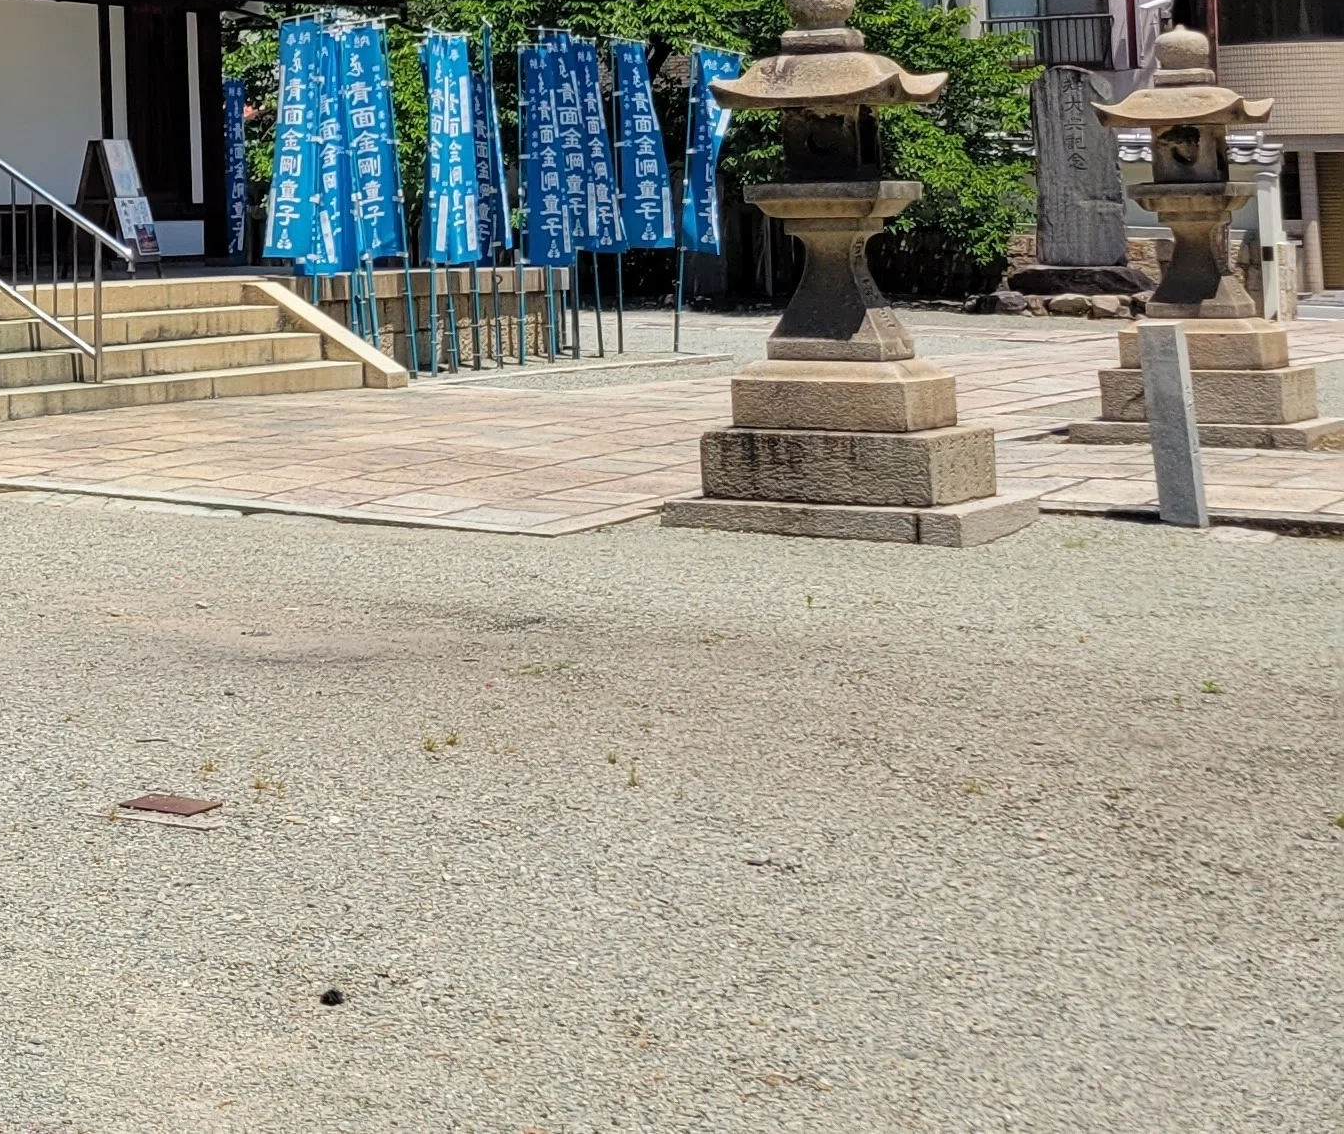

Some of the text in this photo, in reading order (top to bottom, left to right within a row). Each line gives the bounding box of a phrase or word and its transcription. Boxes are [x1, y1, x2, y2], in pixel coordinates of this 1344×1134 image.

[276, 78, 307, 226] 青面金剛童子
[347, 81, 385, 226] 青面金剛童子
